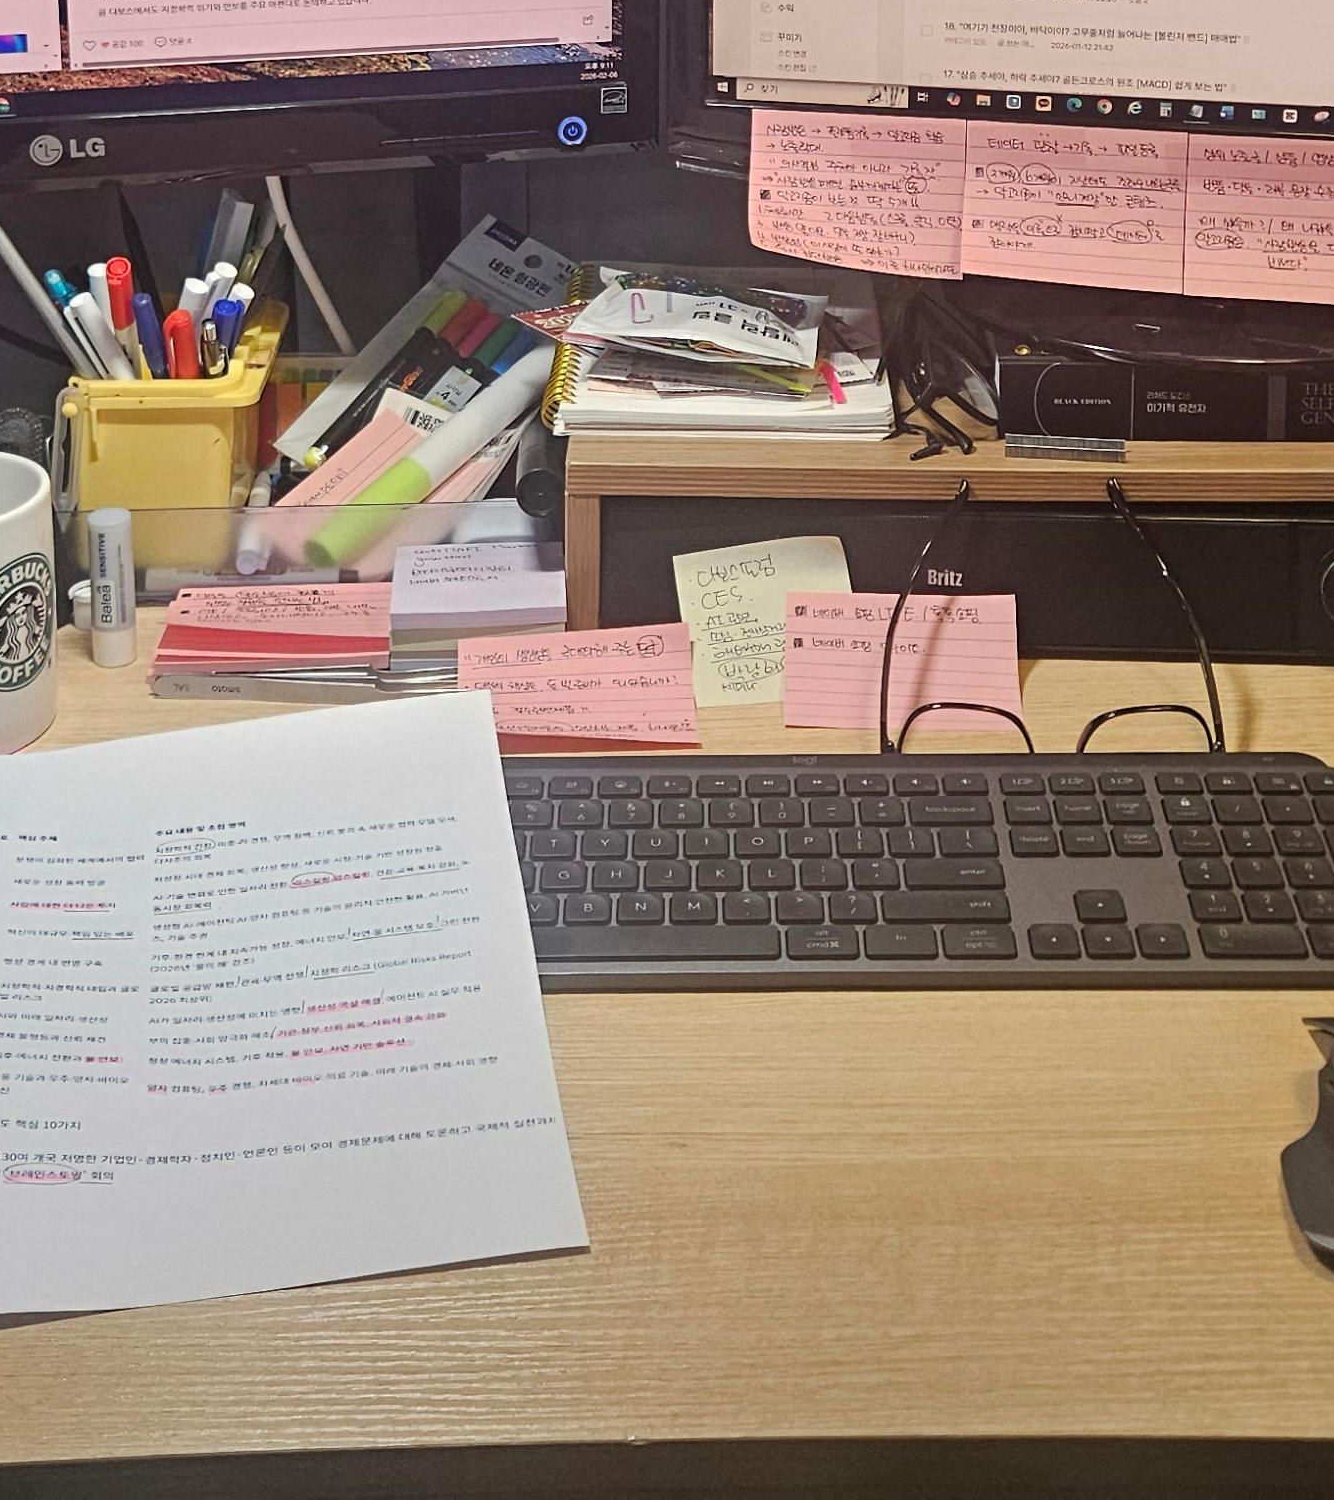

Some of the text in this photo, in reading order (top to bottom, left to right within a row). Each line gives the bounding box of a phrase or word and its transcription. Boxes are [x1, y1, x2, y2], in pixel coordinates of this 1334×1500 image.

[1136, 79, 1172, 90] [MACD]
[69, 138, 105, 158] LG
[488, 257, 552, 297] 네온 형광펜
[1147, 403, 1206, 413] 이기적 유전자
[98, 533, 106, 578] SENSITIVE
[927, 569, 963, 587] Britz
[96, 584, 114, 625] Balea
[411, 954, 436, 964] Risks
[439, 950, 472, 960] Report
[43, 1120, 81, 1131] 10가지
[33, 1152, 57, 1163] 개국
